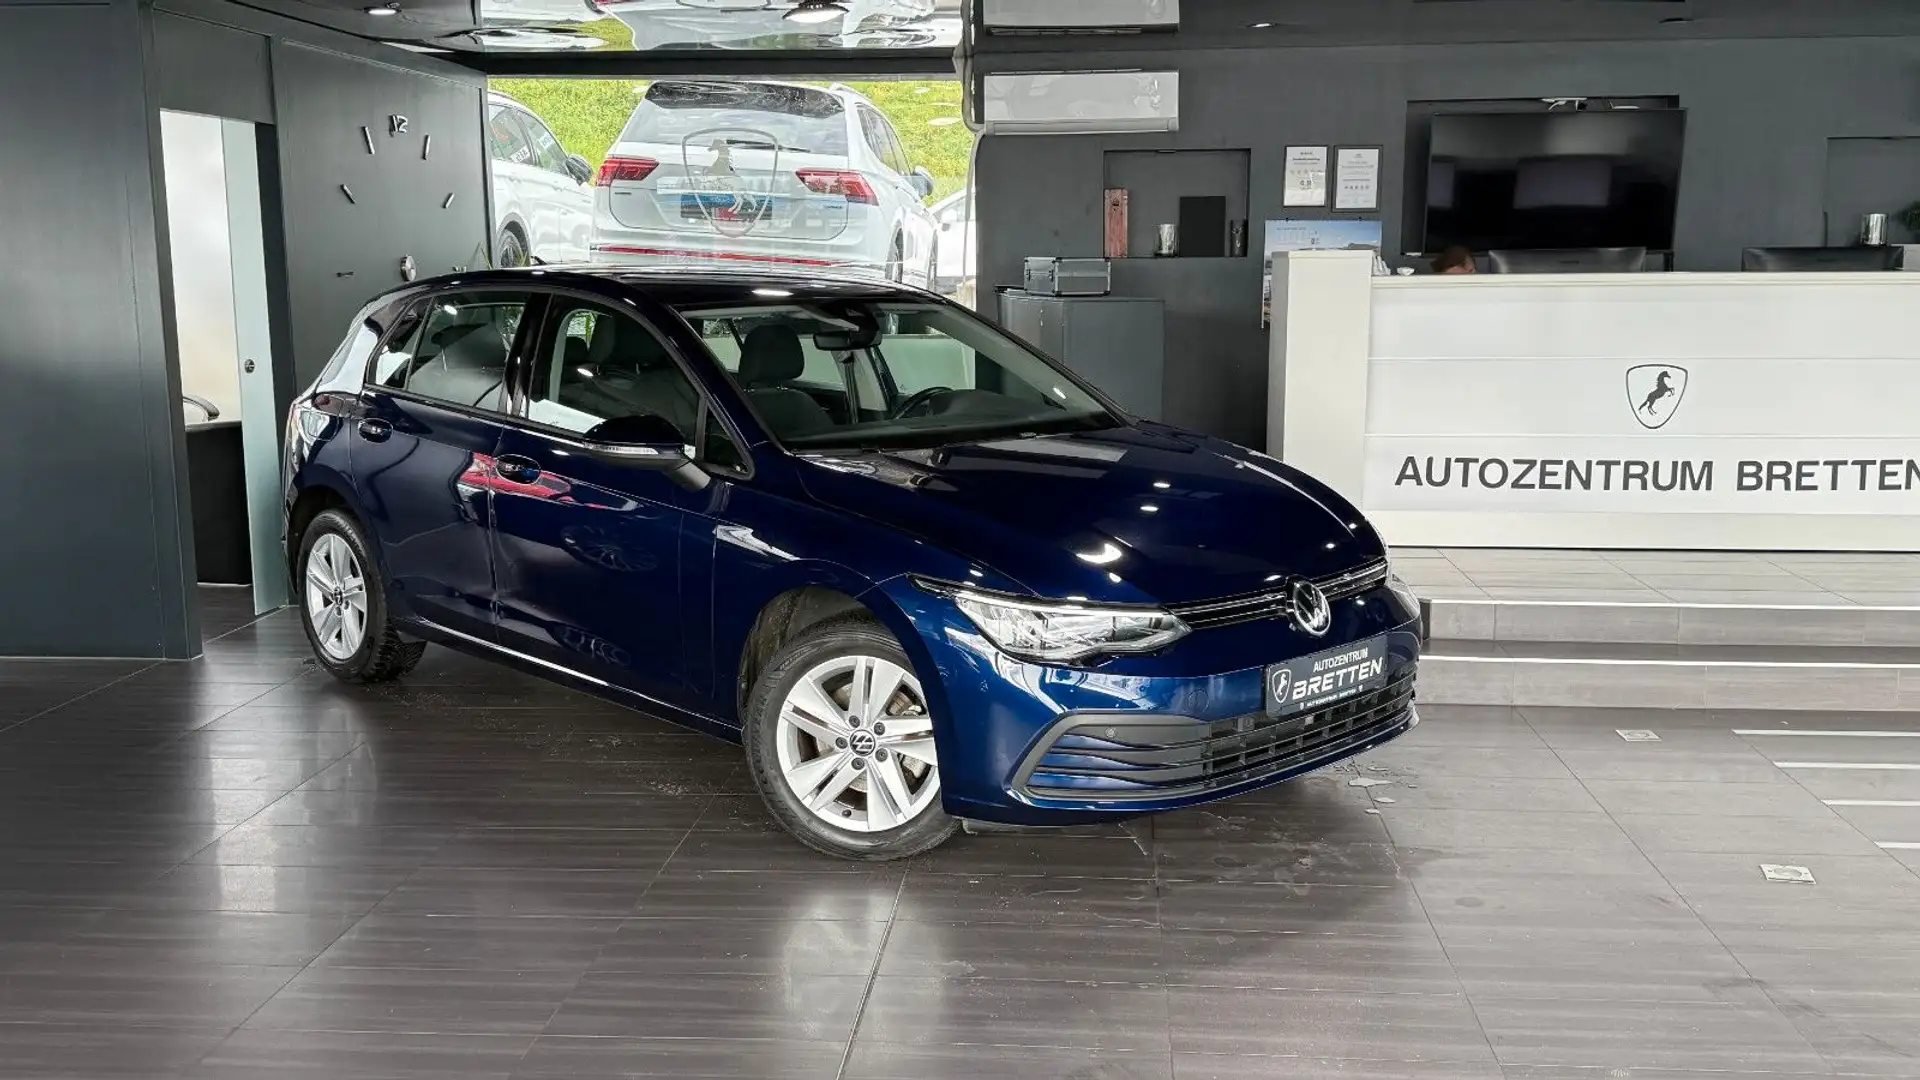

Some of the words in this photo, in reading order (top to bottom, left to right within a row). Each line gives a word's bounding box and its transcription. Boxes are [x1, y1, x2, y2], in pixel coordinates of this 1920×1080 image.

[1395, 456, 1714, 491] AUTOZENTRUM
[1736, 459, 1920, 491] BRETTEN
[1312, 646, 1369, 673] AUTOZENTRUM
[1292, 656, 1384, 701] BRETTEN
